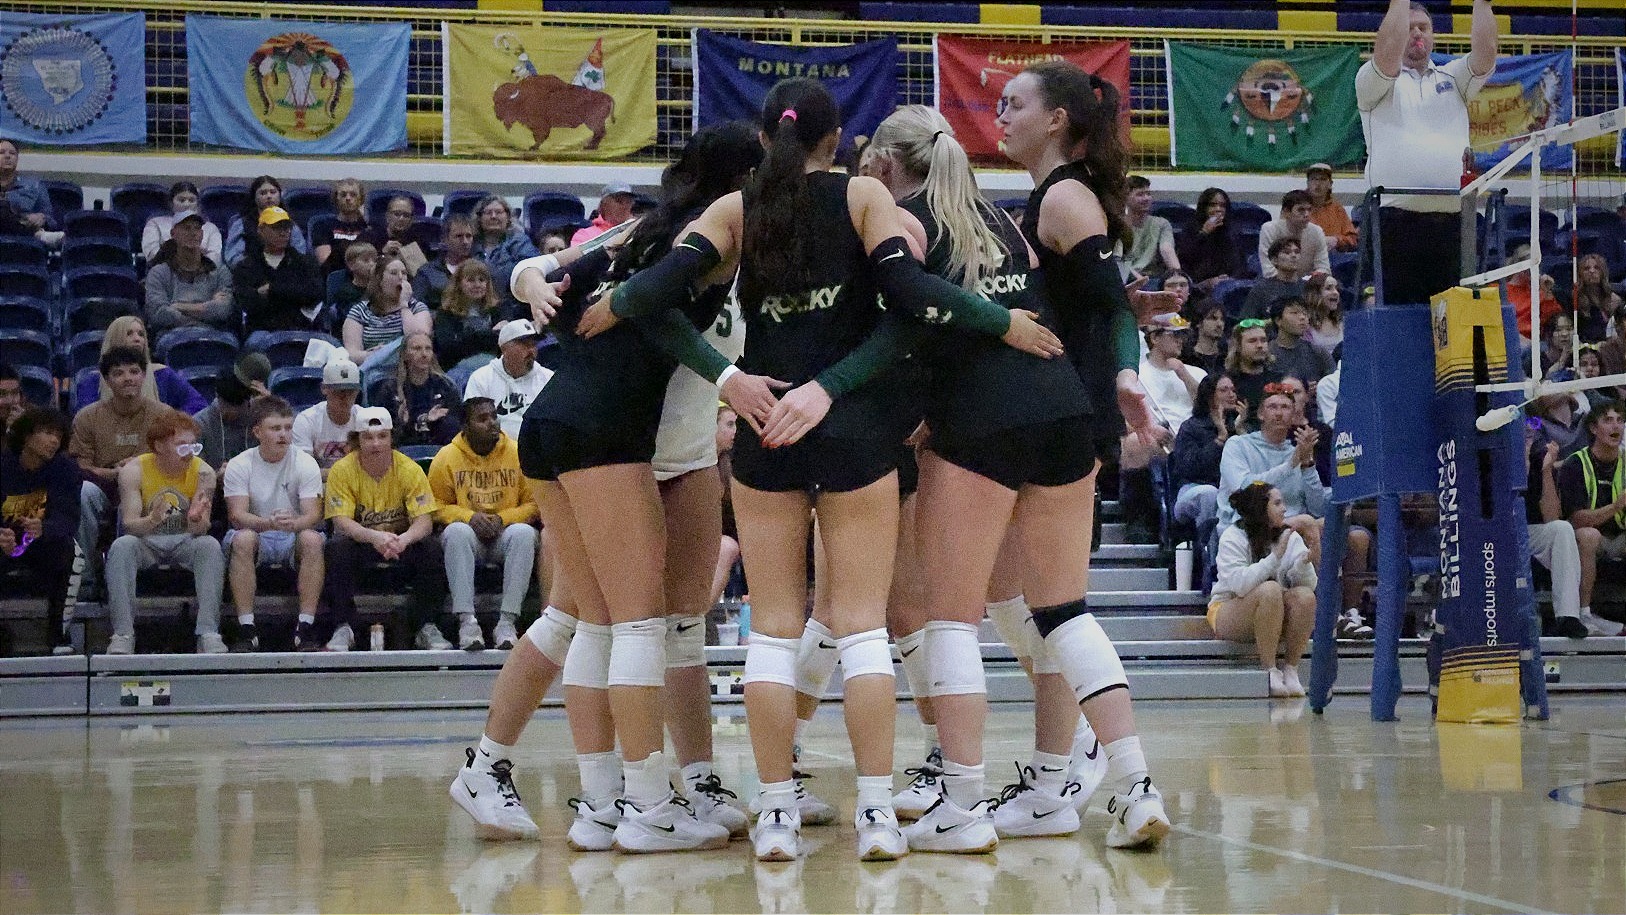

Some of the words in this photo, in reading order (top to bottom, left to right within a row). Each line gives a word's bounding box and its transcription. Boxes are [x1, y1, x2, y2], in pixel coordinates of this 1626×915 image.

[738, 57, 850, 78] MONTANA
[1335, 444, 1363, 460] AMERICAN
[455, 468, 518, 490] WYOMING
[1446, 439, 1461, 598] BILLINGS
[1481, 542, 1497, 588] sports
[1483, 589, 1499, 647] imports
